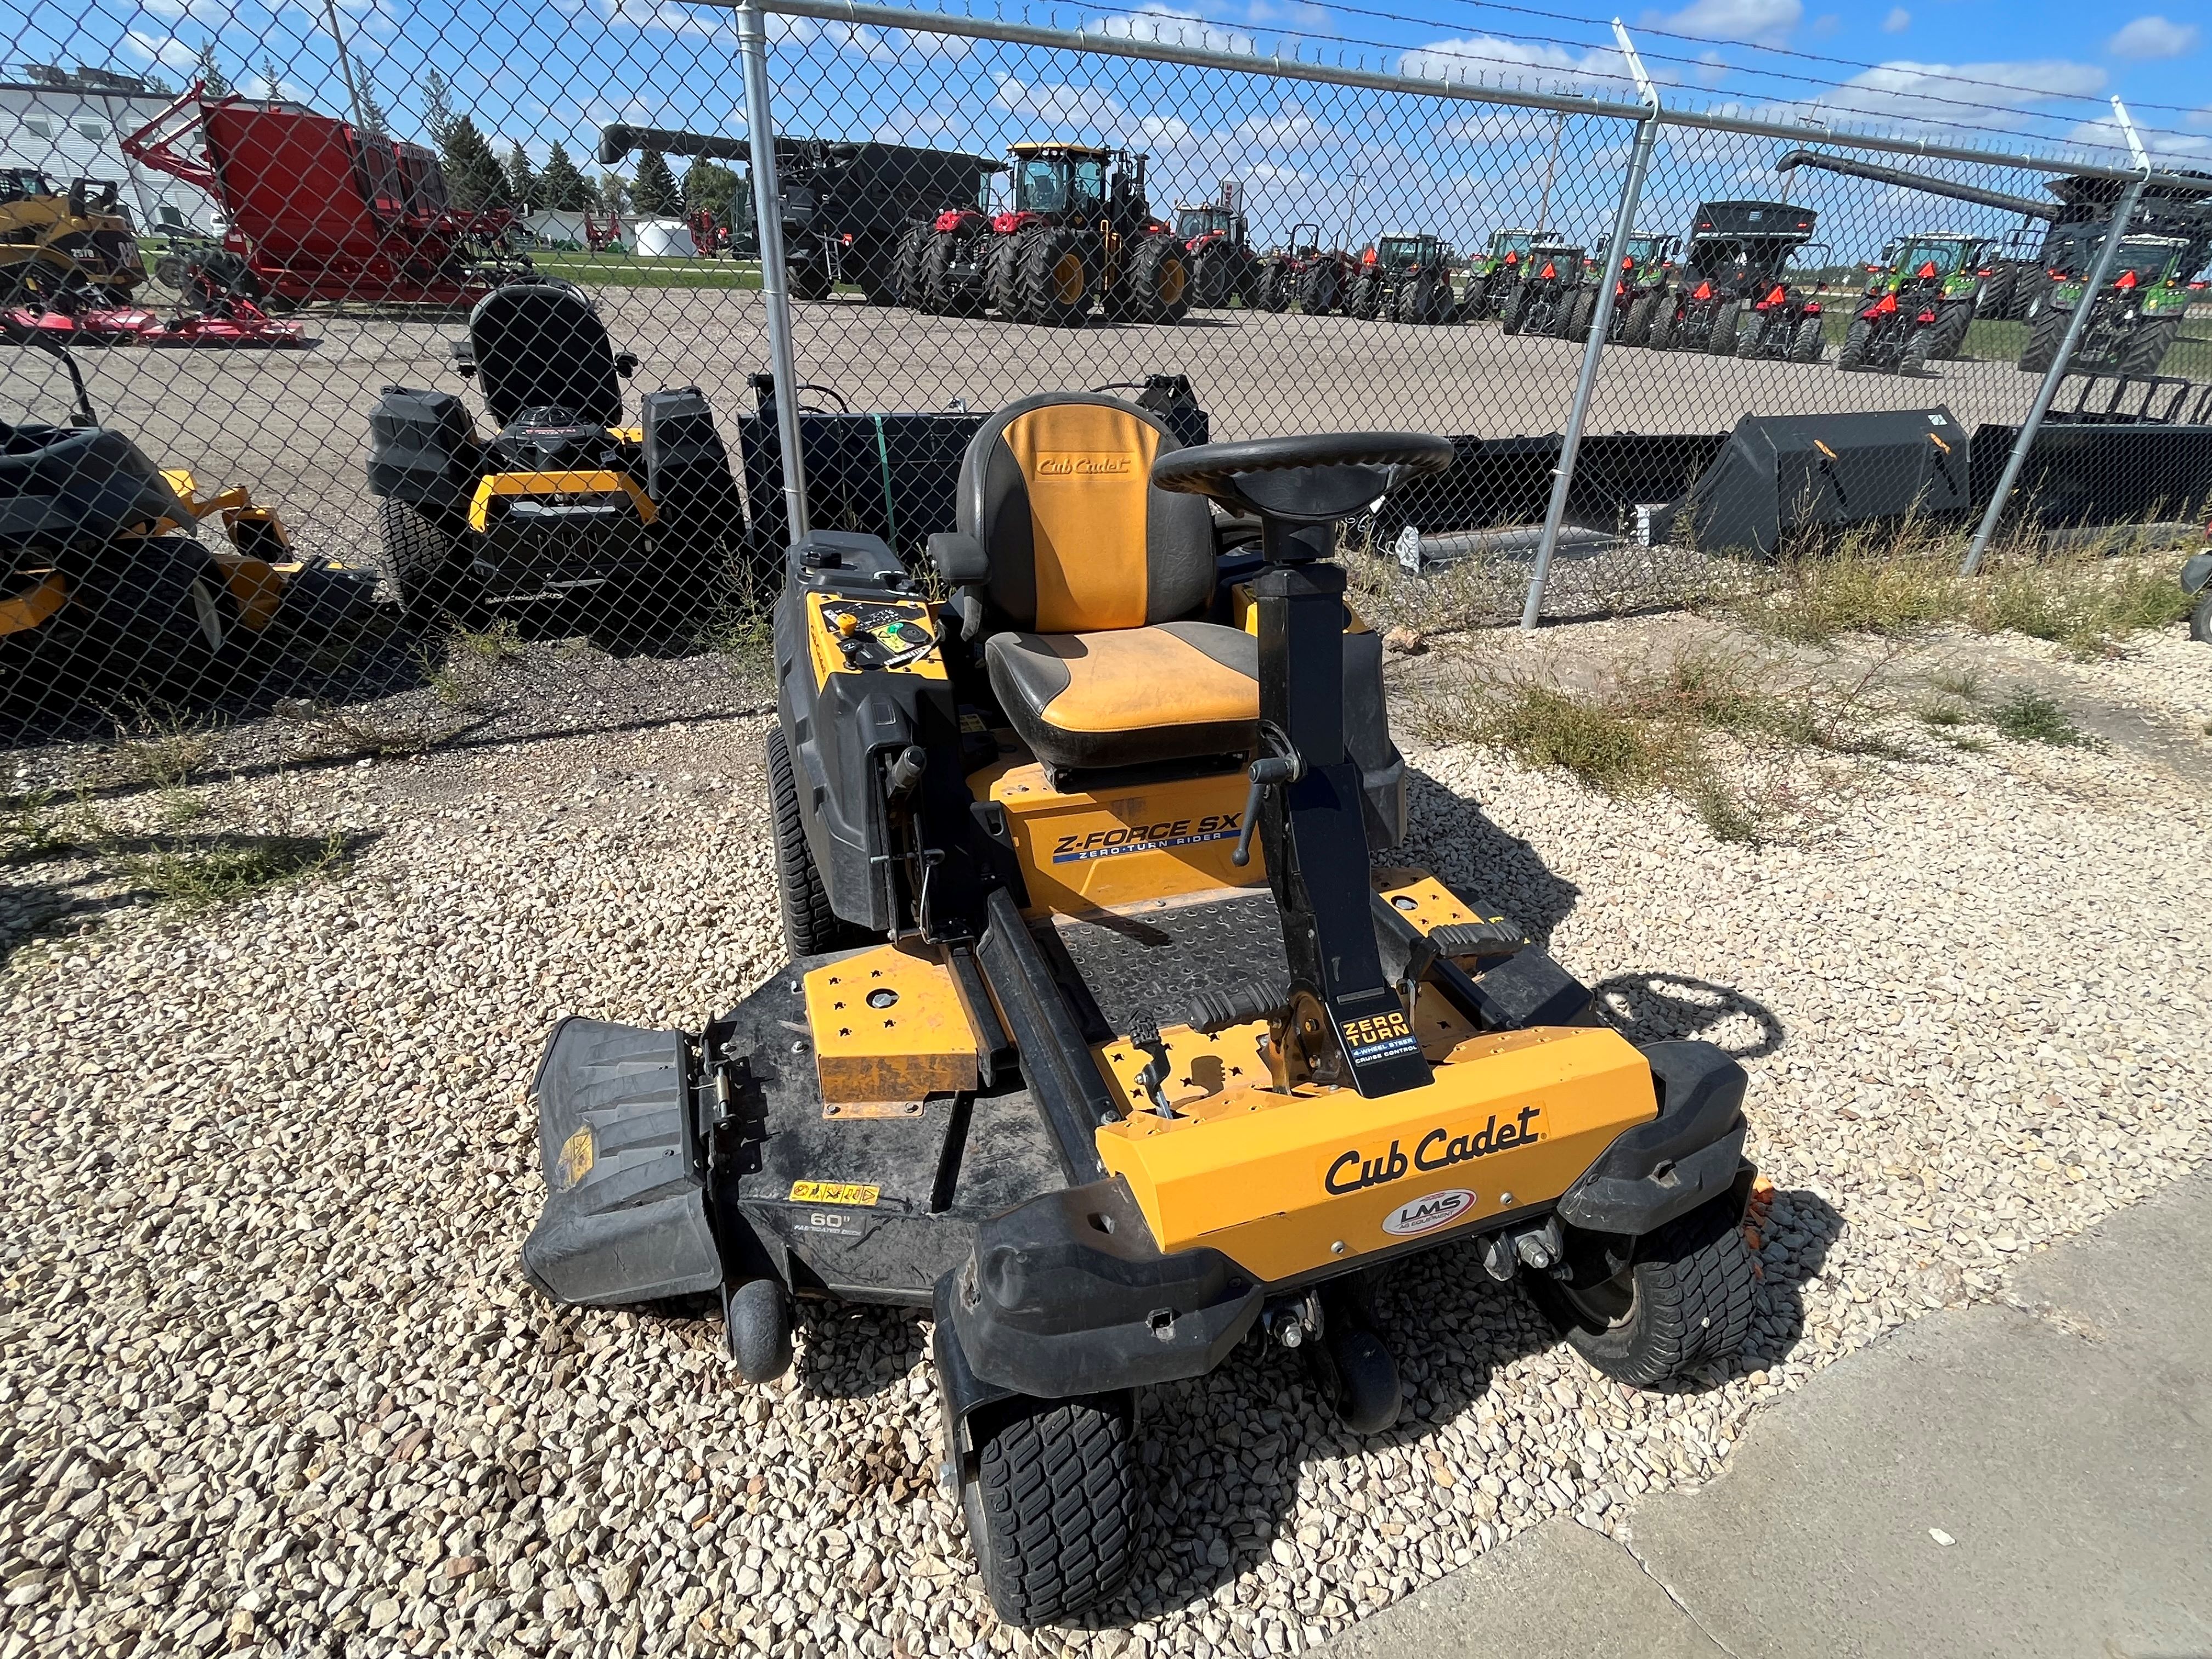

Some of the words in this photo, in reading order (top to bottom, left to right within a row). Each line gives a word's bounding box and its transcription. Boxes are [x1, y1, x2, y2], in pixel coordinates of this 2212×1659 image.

[1036, 458, 1073, 475] Cub
[1072, 457, 1131, 475] Cadet
[1053, 820, 1192, 854] Z-FORCE
[1197, 812, 1242, 833] SX
[1177, 832, 1222, 845] RIDER
[1343, 1012, 1404, 1036] ZERO
[1347, 1023, 1410, 1047] TURN
[1353, 1044, 1388, 1056] 4-WHEEL
[1388, 1037, 1414, 1048] STEER
[1355, 1053, 1383, 1064] CRUISE
[1384, 1046, 1418, 1057] CONTROL
[1324, 1139, 1408, 1195] Cub
[1414, 1105, 1541, 1171] Cadet
[1400, 1194, 1462, 1223] LMS
[810, 1212, 850, 1228] 60"
[1411, 1210, 1454, 1227] EQUIPMENT
